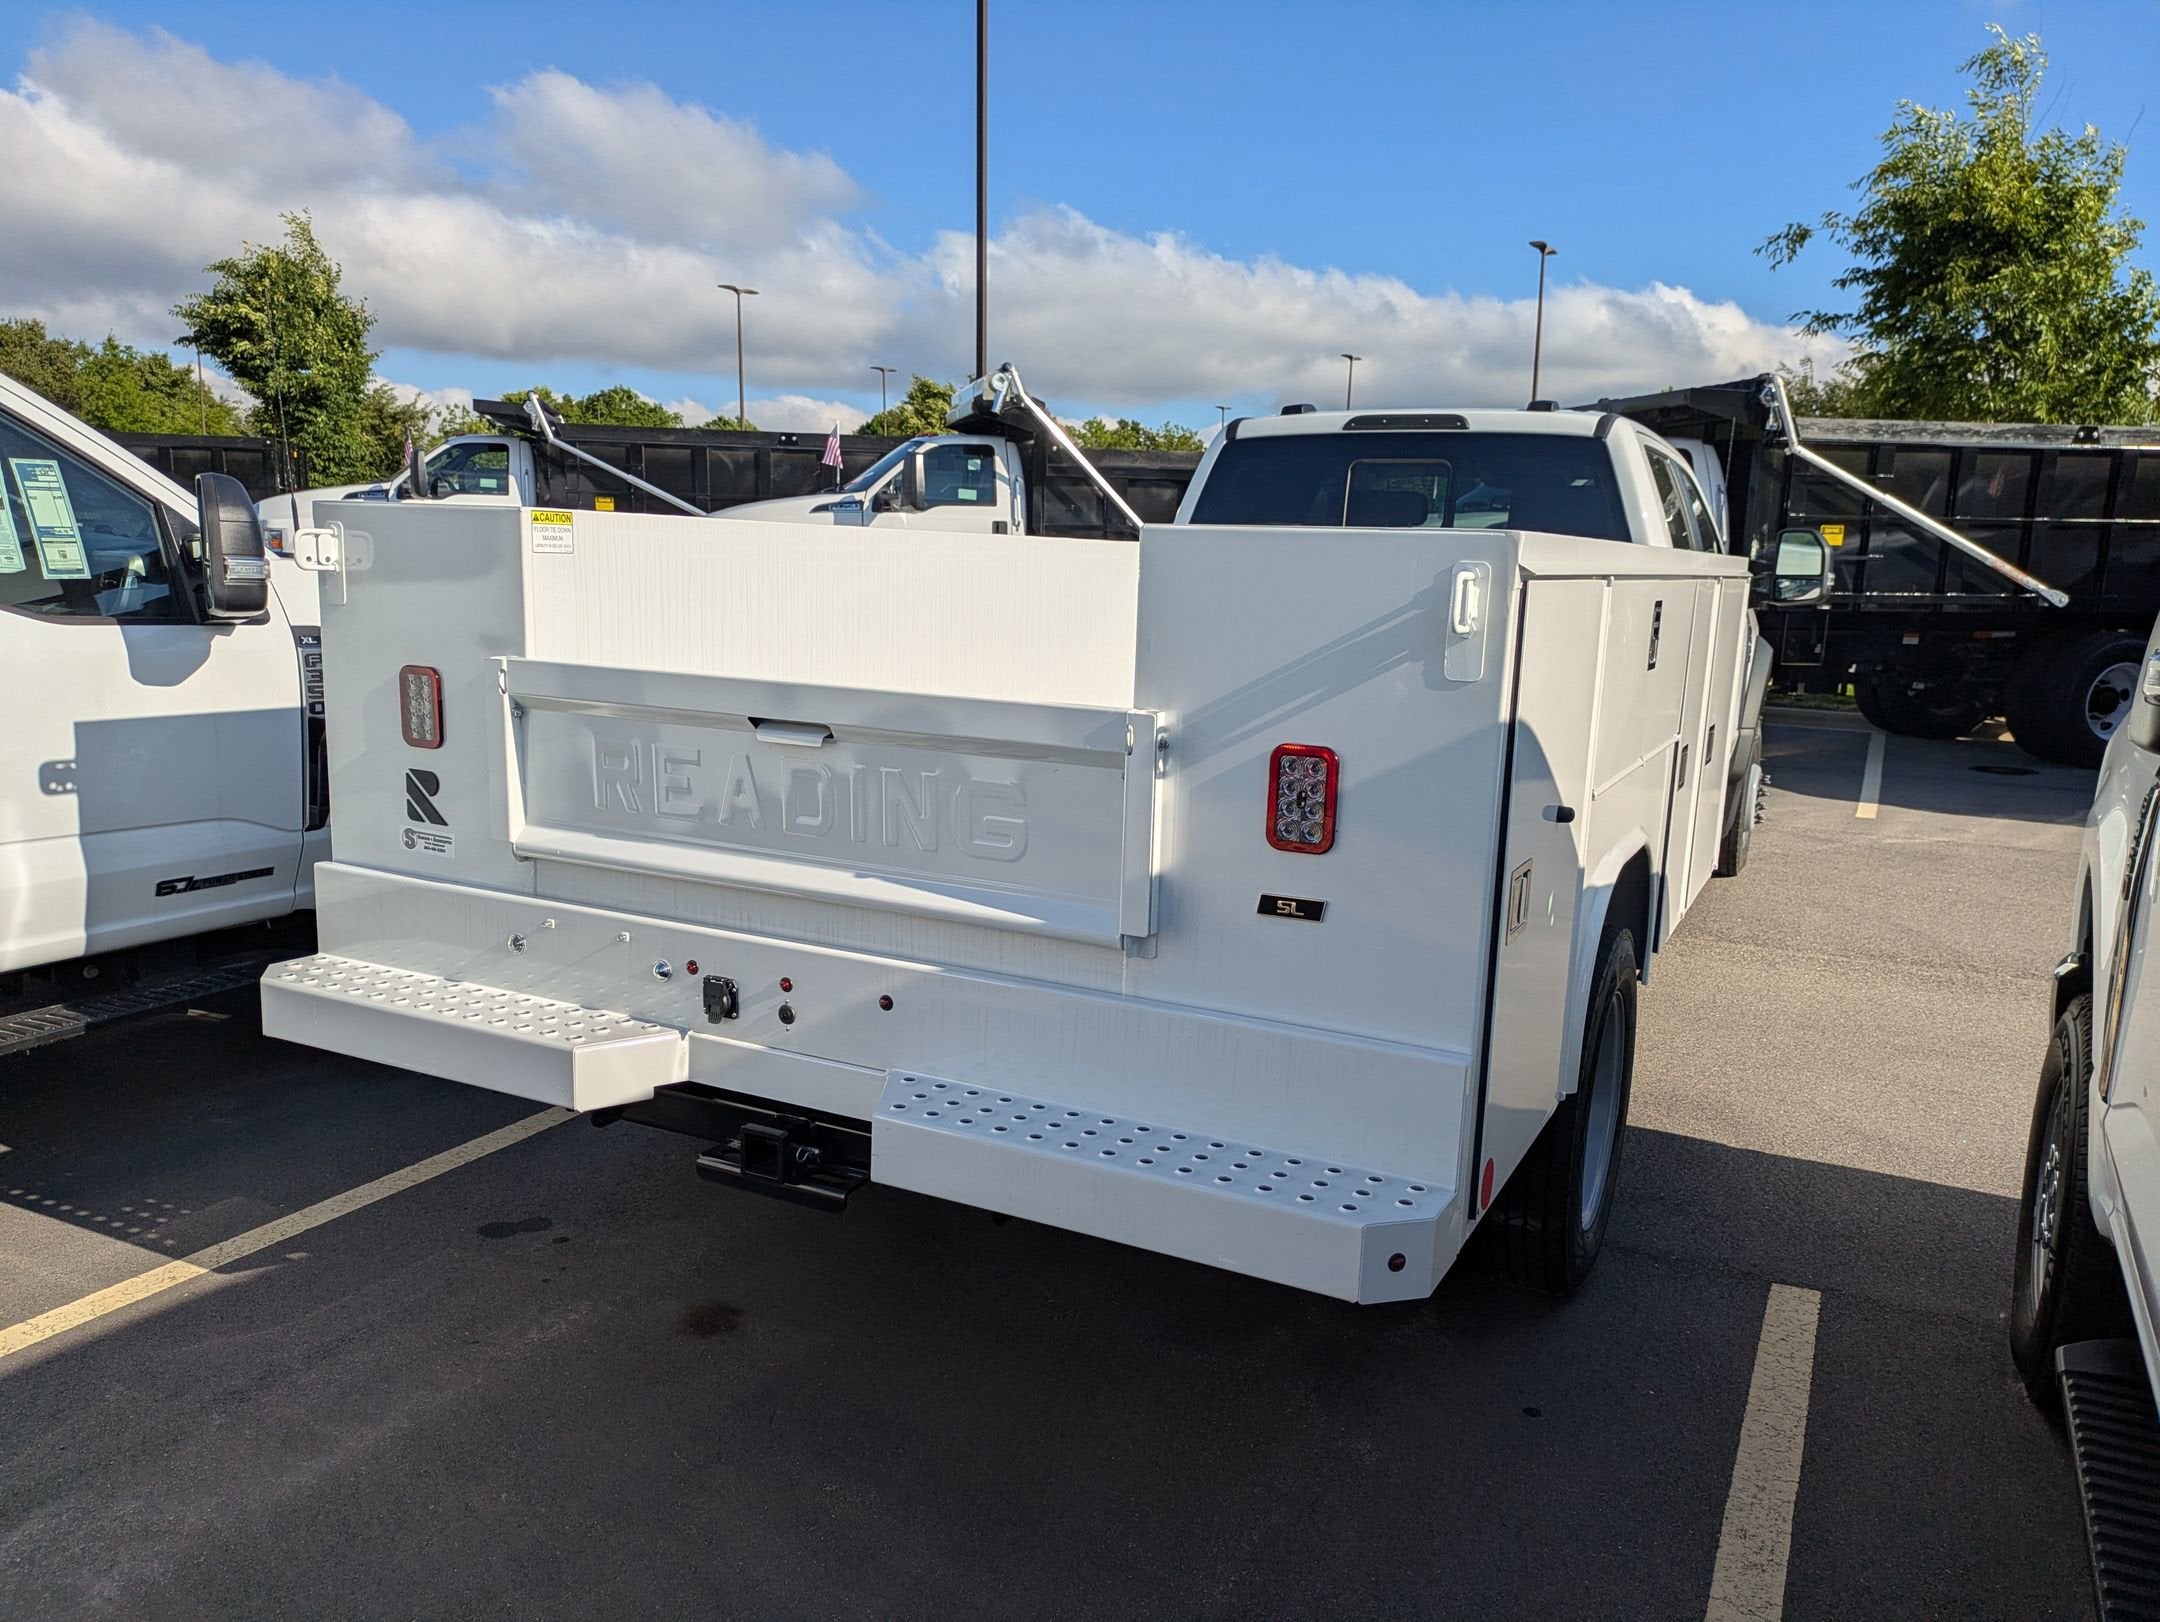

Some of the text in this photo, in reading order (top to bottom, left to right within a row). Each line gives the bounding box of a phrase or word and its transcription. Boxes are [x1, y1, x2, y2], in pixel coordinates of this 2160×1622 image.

[540, 512, 572, 523] CAUTION
[558, 526, 571, 534] DOWN
[300, 636, 318, 645] XL
[590, 735, 1029, 862] READING
[1276, 900, 1305, 916] SL
